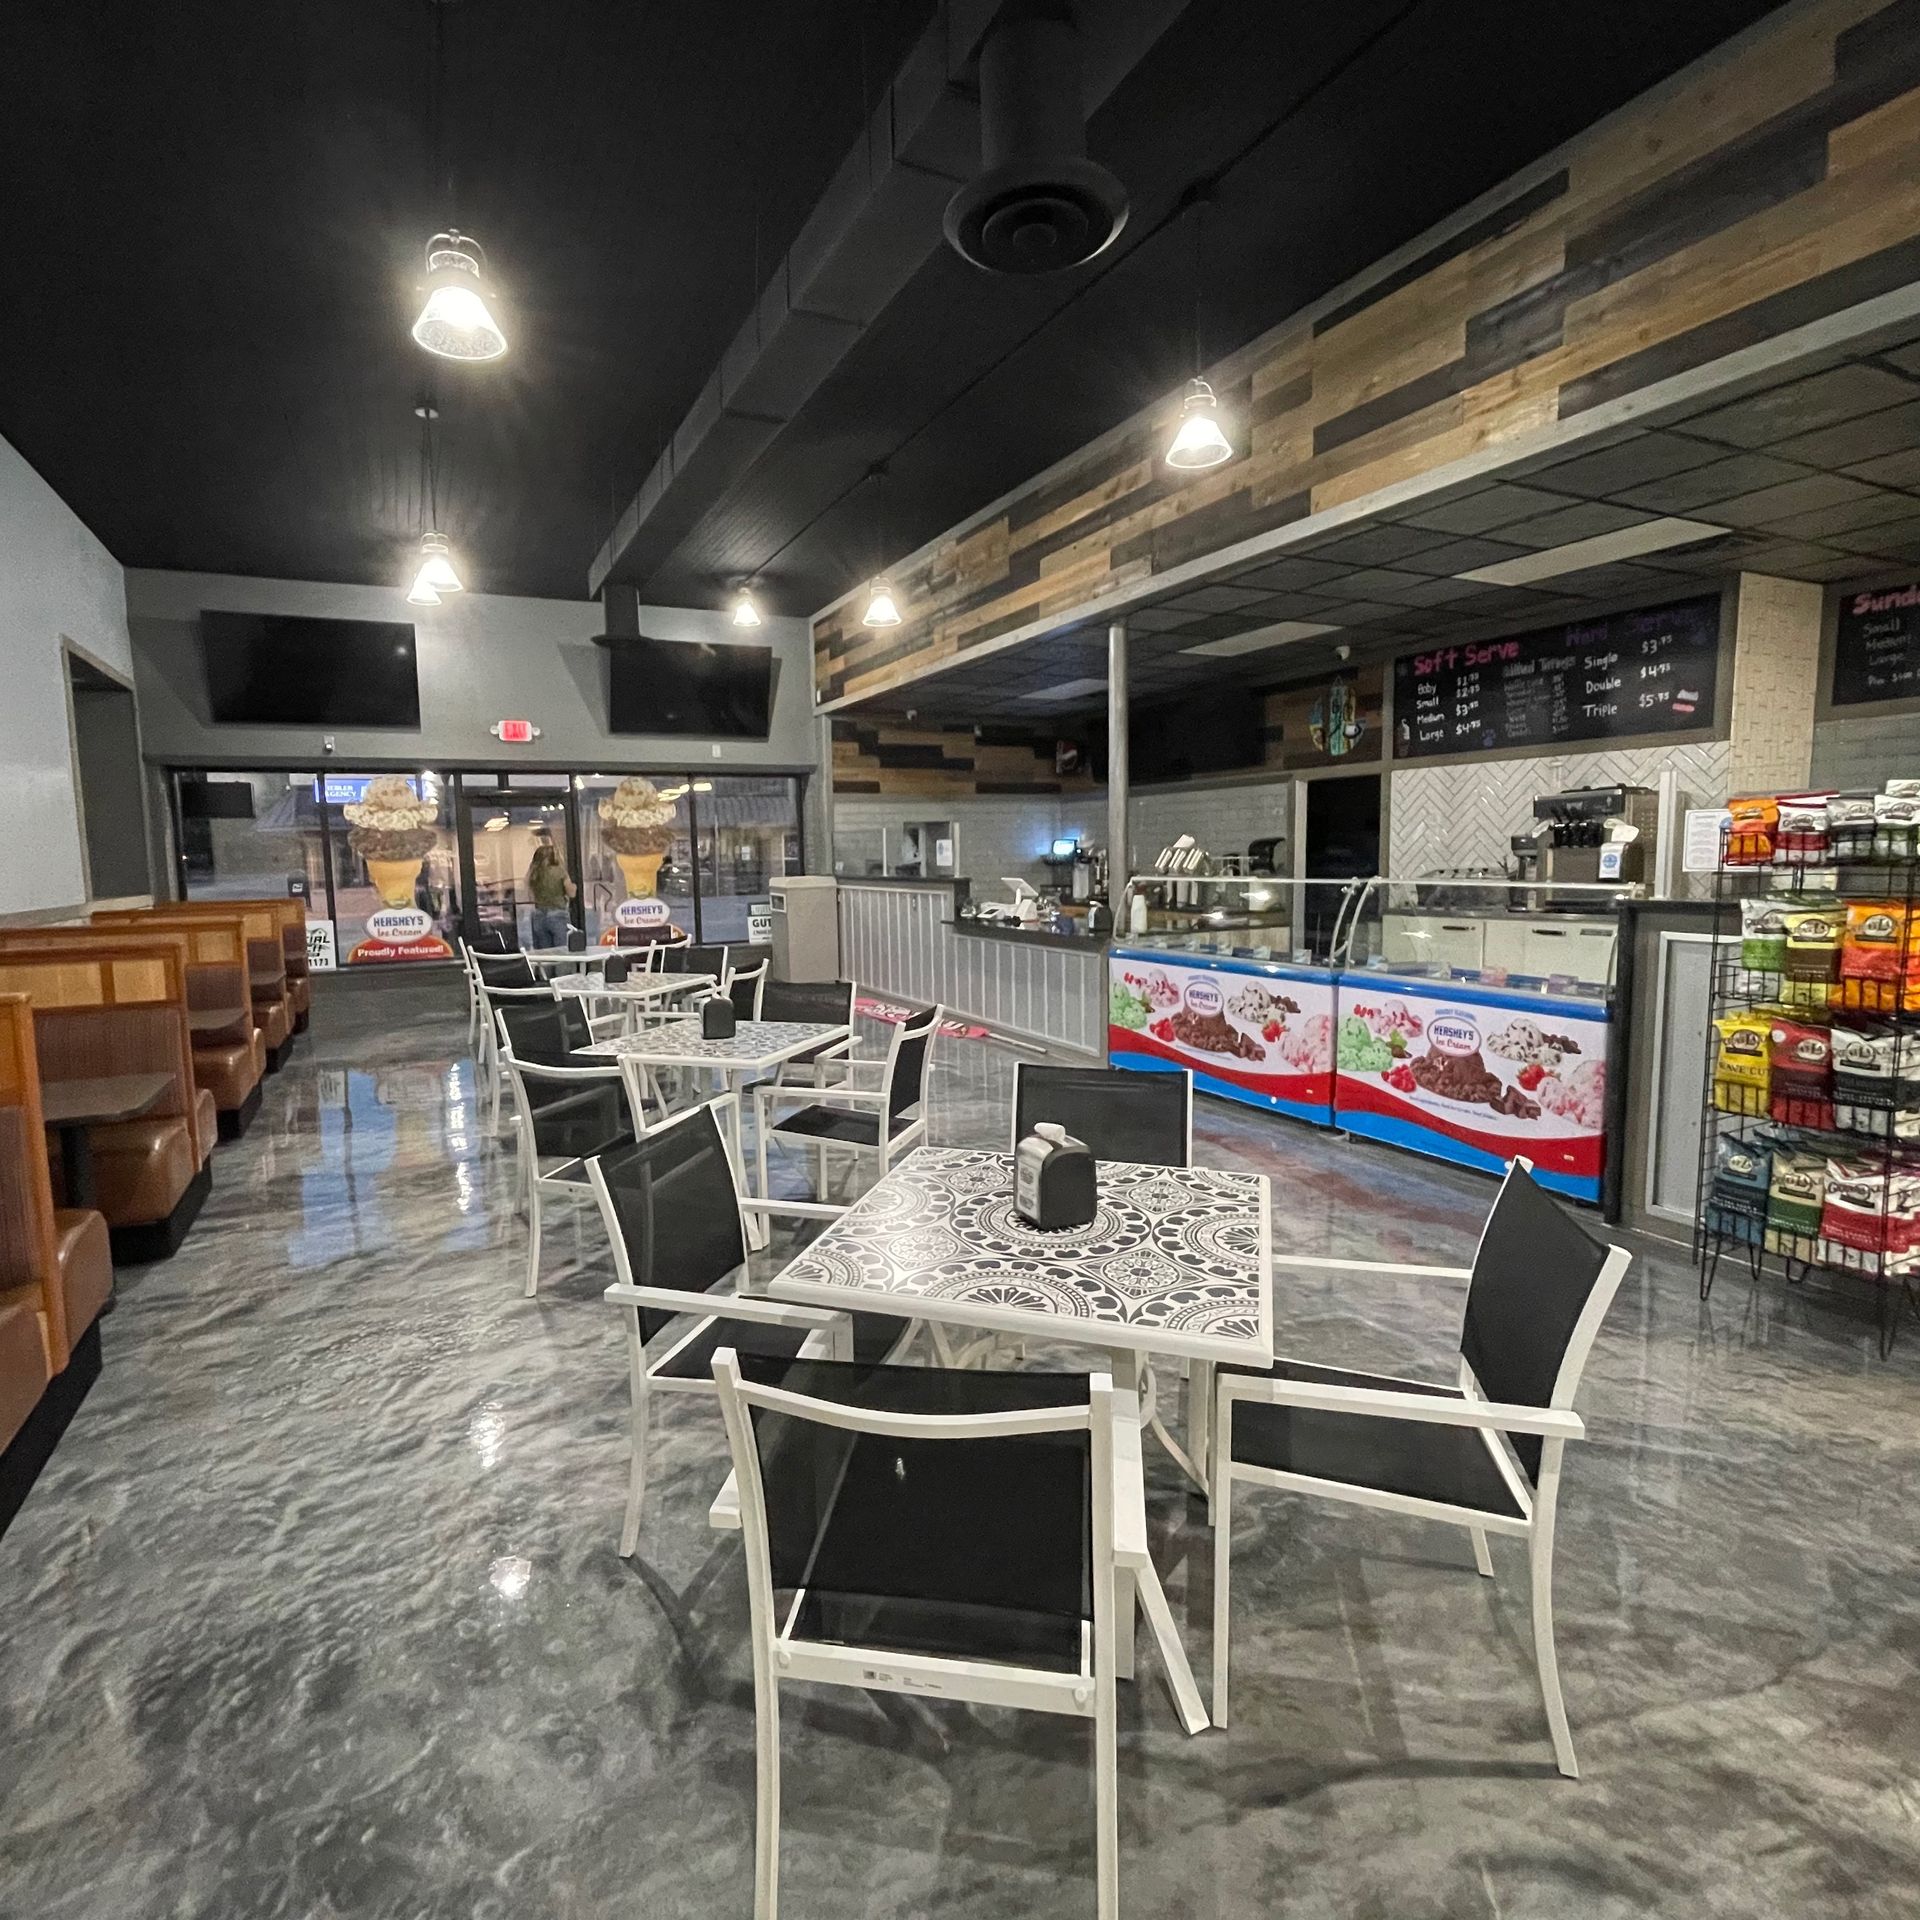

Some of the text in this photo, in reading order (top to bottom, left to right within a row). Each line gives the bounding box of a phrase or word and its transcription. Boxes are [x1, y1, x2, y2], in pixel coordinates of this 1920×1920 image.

[1413, 641, 1520, 676] Soft Serve
[1584, 652, 1619, 671] Single
[1586, 677, 1622, 695] Double
[1416, 696, 1440, 711] Small
[1417, 712, 1446, 725] Medium
[1582, 703, 1618, 720] Triple
[1419, 729, 1445, 743] Large
[621, 905, 664, 915] HERSHEY'S
[373, 915, 424, 927] HERSHEY'S
[624, 914, 662, 924] Ice Cream
[752, 918, 772, 927] GUT
[377, 927, 422, 937] Ice Cream
[357, 944, 444, 958] Proudly Featured!
[1433, 1025, 1475, 1041] HERSHEY'S
[1436, 1036, 1471, 1050] Ice Cream
